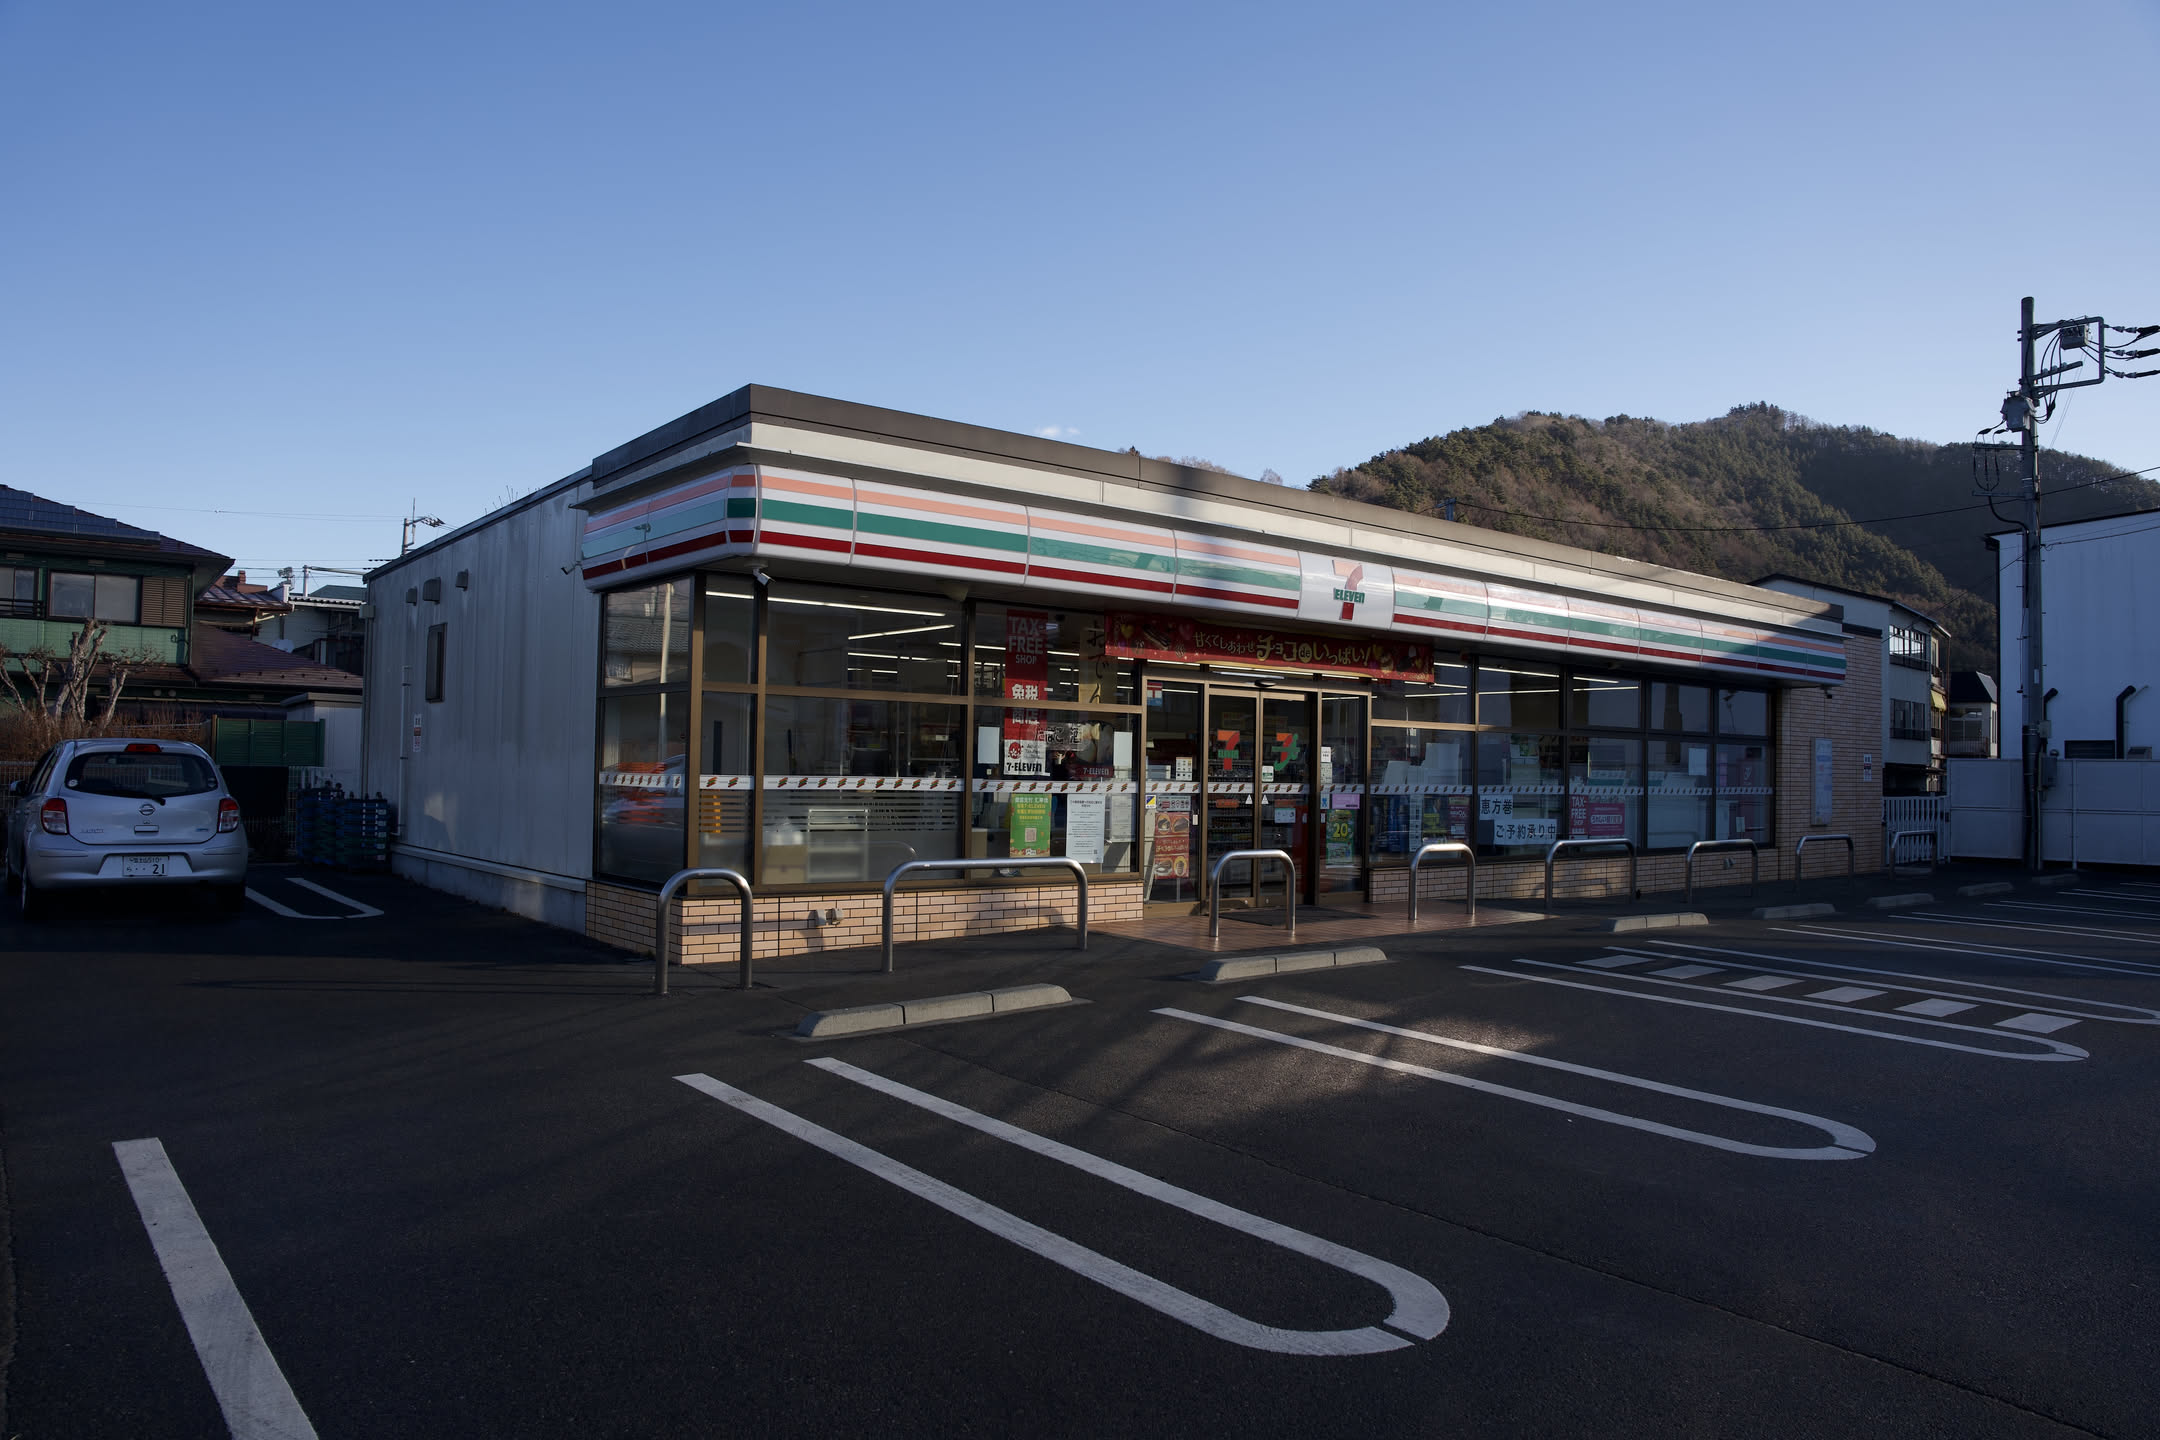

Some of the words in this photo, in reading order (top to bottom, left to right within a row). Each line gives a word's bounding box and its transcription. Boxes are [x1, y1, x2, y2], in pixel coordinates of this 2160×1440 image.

[1008, 636, 1044, 654] FREE
[1193, 631, 1255, 654] 甘くてしあわせ
[1016, 654, 1038, 664] SHOP
[1011, 684, 1039, 700] 免税
[1481, 799, 1513, 815] 恵方巻
[1571, 808, 1587, 819] FREE
[1496, 824, 1556, 839] ご予約承り中
